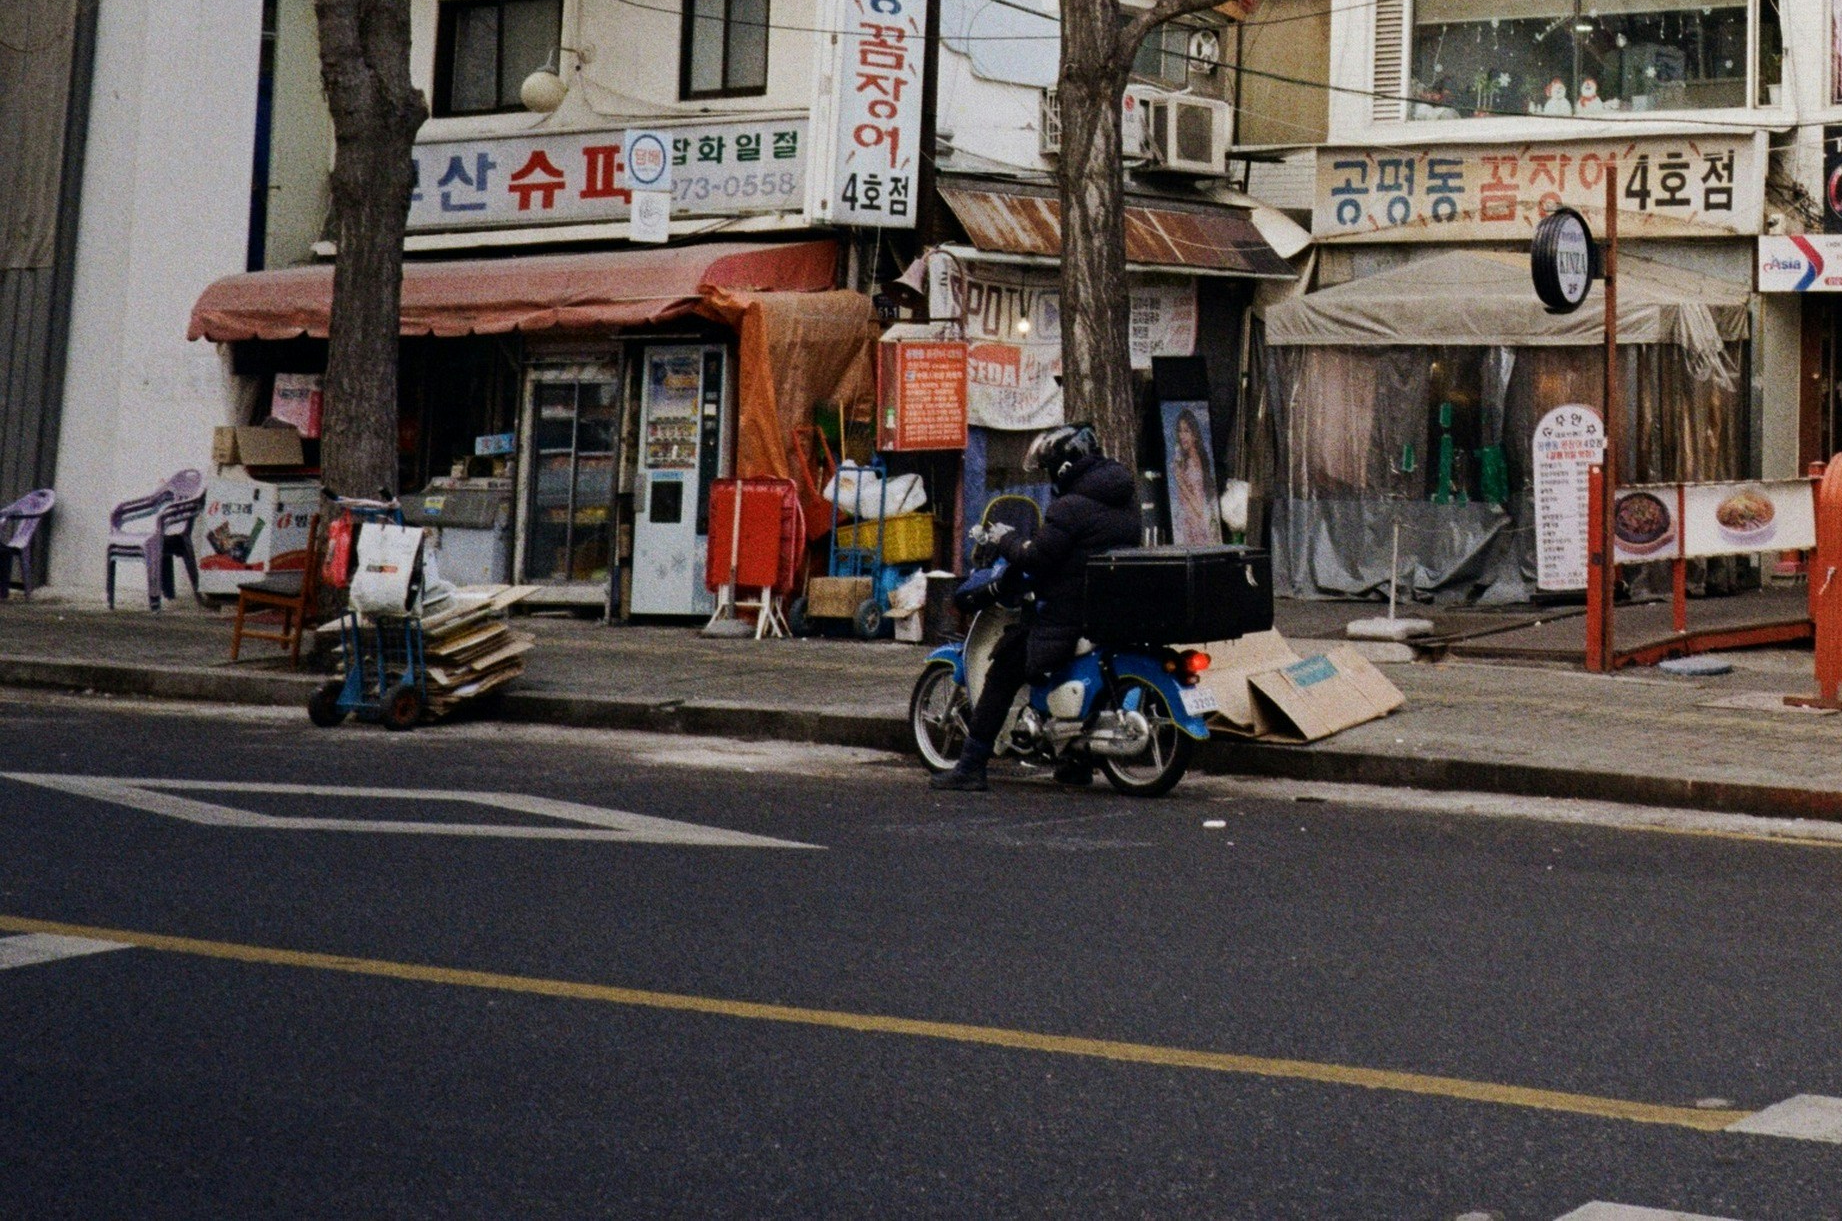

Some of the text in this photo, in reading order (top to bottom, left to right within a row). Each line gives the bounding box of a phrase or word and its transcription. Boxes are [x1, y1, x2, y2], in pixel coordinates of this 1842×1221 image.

[853, 21, 909, 169] 꼼장어
[841, 172, 909, 217] 4호점
[1479, 152, 1612, 223] 꼼장어
[1625, 149, 1736, 213] 4호점
